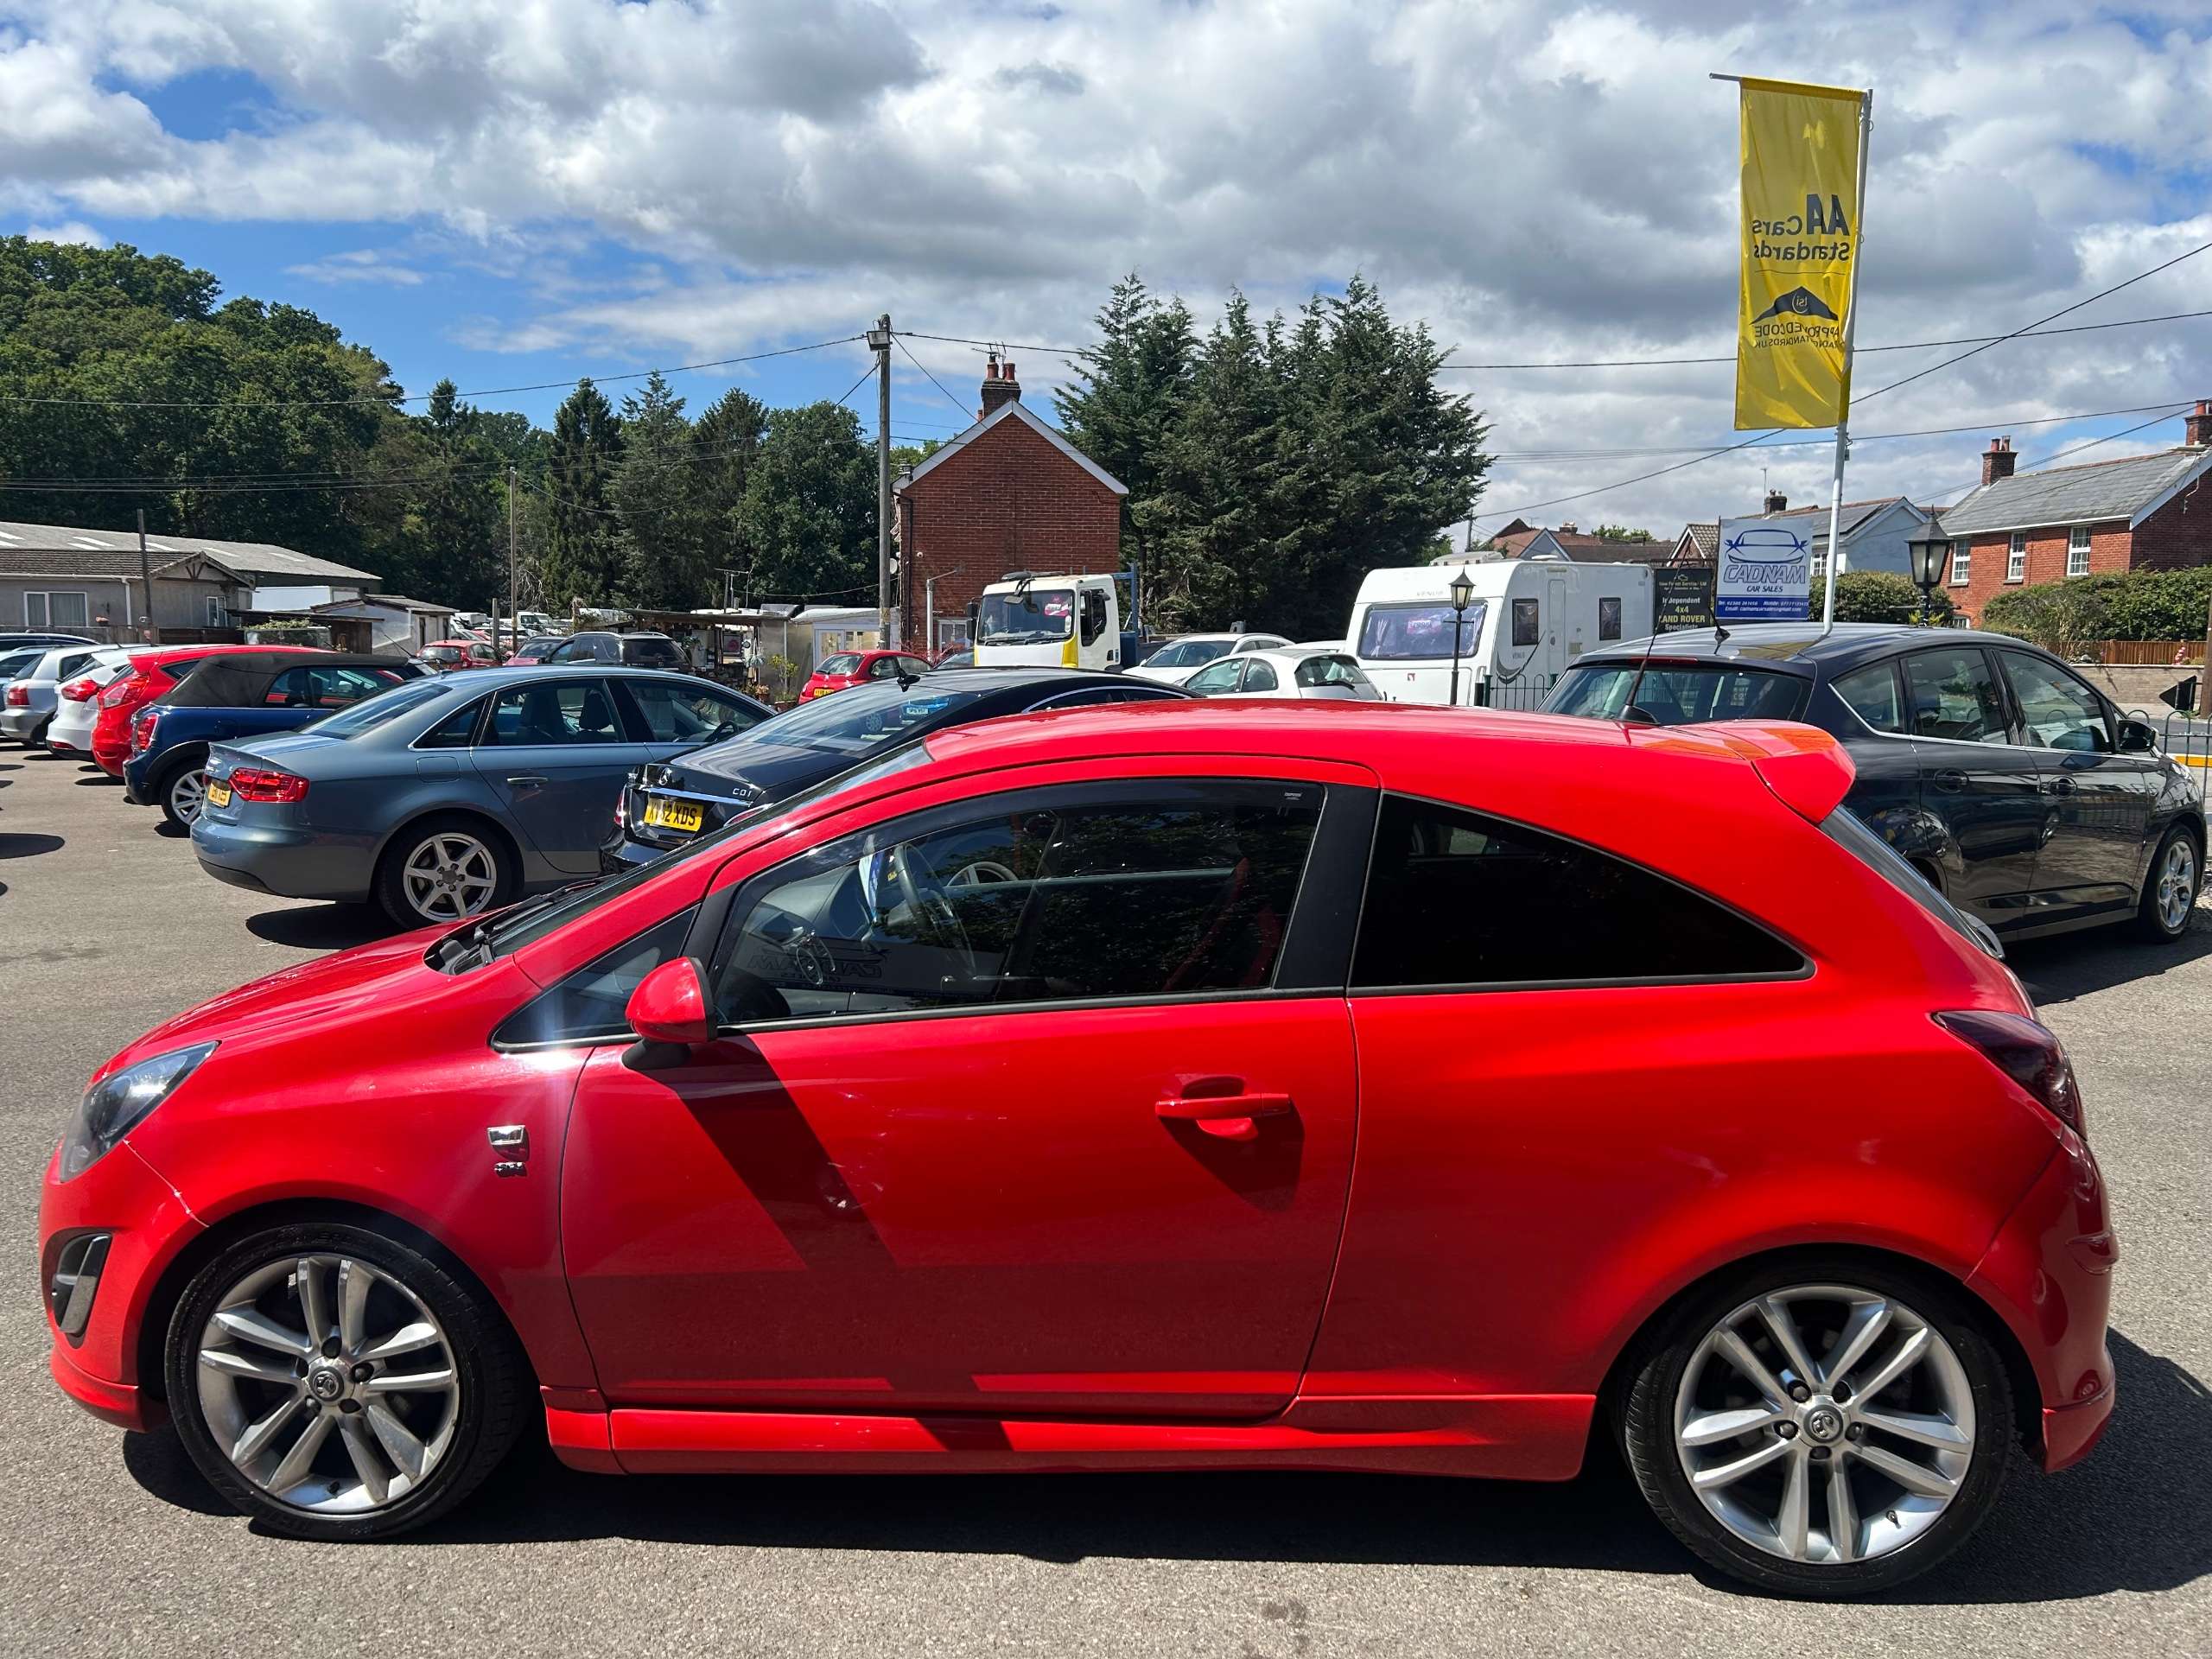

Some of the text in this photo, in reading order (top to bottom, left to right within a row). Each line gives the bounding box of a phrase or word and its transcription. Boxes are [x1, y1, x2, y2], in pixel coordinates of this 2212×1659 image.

[1723, 564, 1806, 584] CADNAM
[732, 787, 753, 798] CDI
[673, 804, 697, 826] XDS
